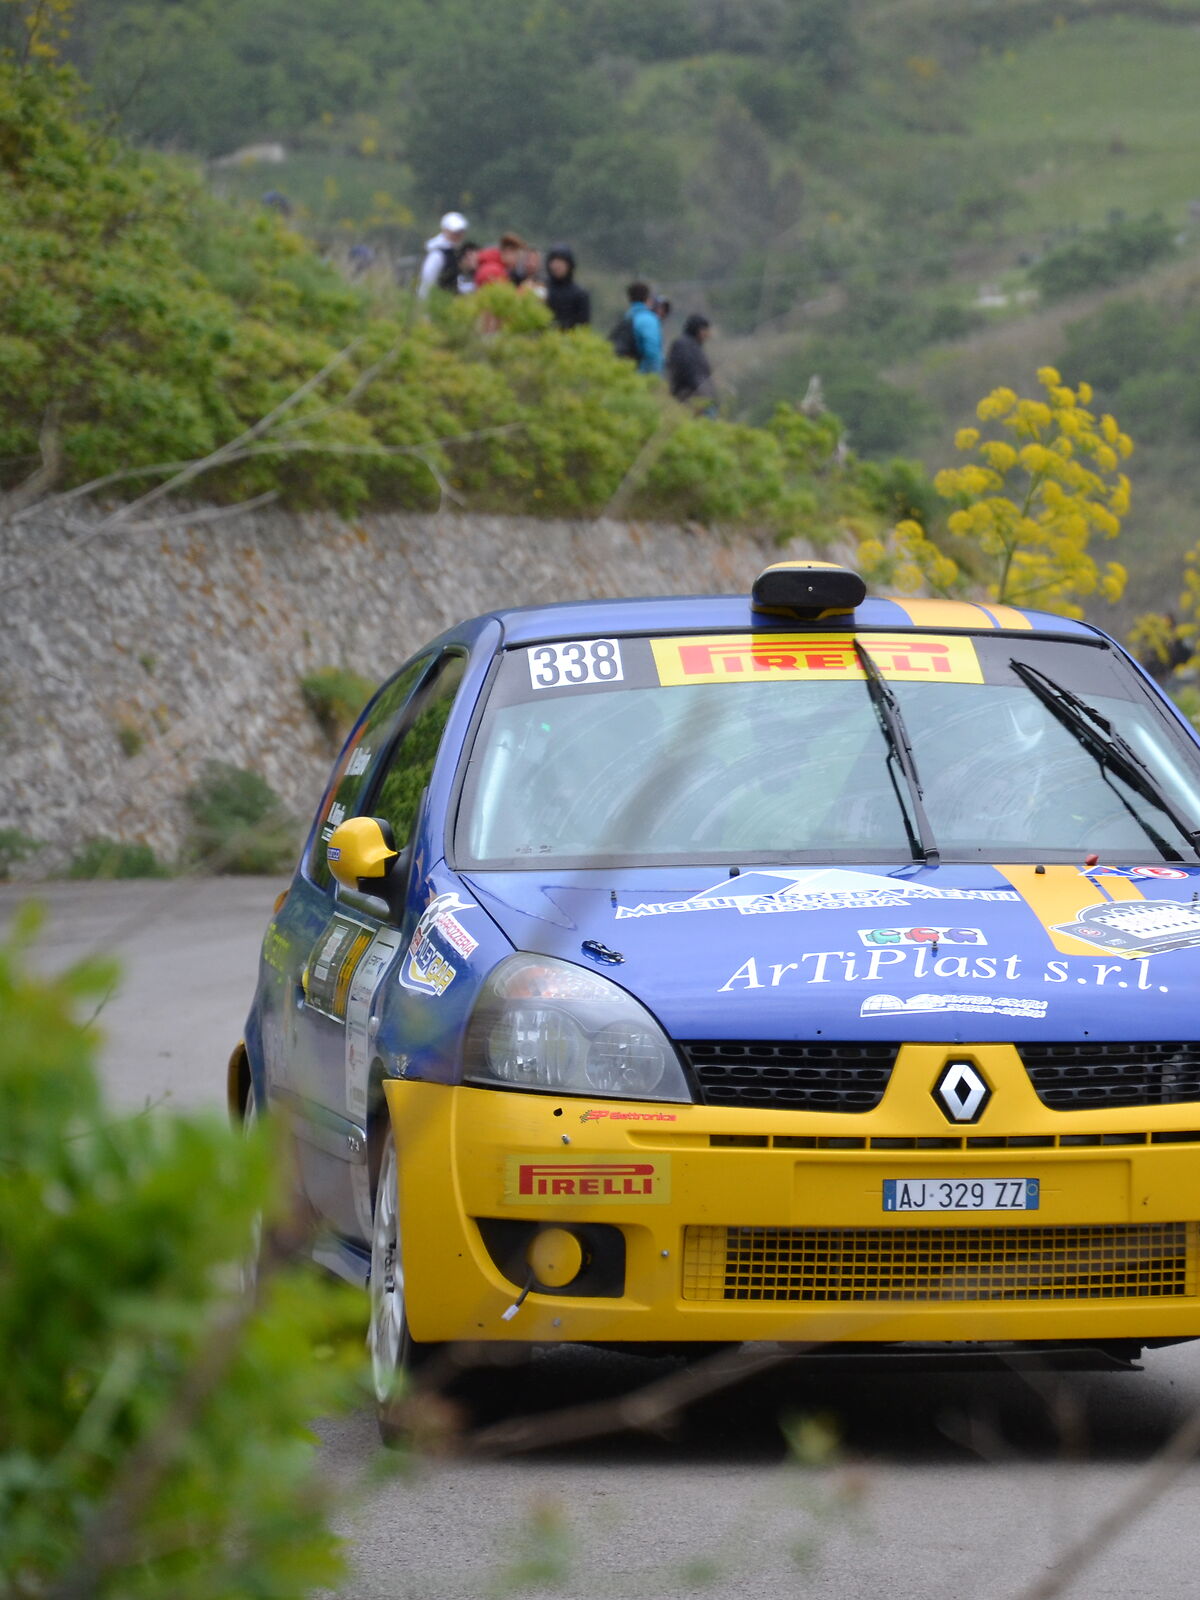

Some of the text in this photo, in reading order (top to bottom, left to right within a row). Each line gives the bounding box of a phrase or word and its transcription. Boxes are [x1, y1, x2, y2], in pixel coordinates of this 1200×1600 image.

[533, 640, 618, 686] 338
[677, 641, 952, 675] PIRELLI
[750, 888, 1017, 904] ARREDAMENTI
[717, 947, 1169, 993] ArTiPlast s.r.l.
[519, 1164, 654, 1195] PIRELLI
[899, 1183, 926, 1208] AJ
[939, 1183, 984, 1208] 329
[995, 1182, 1023, 1208] ZZ
